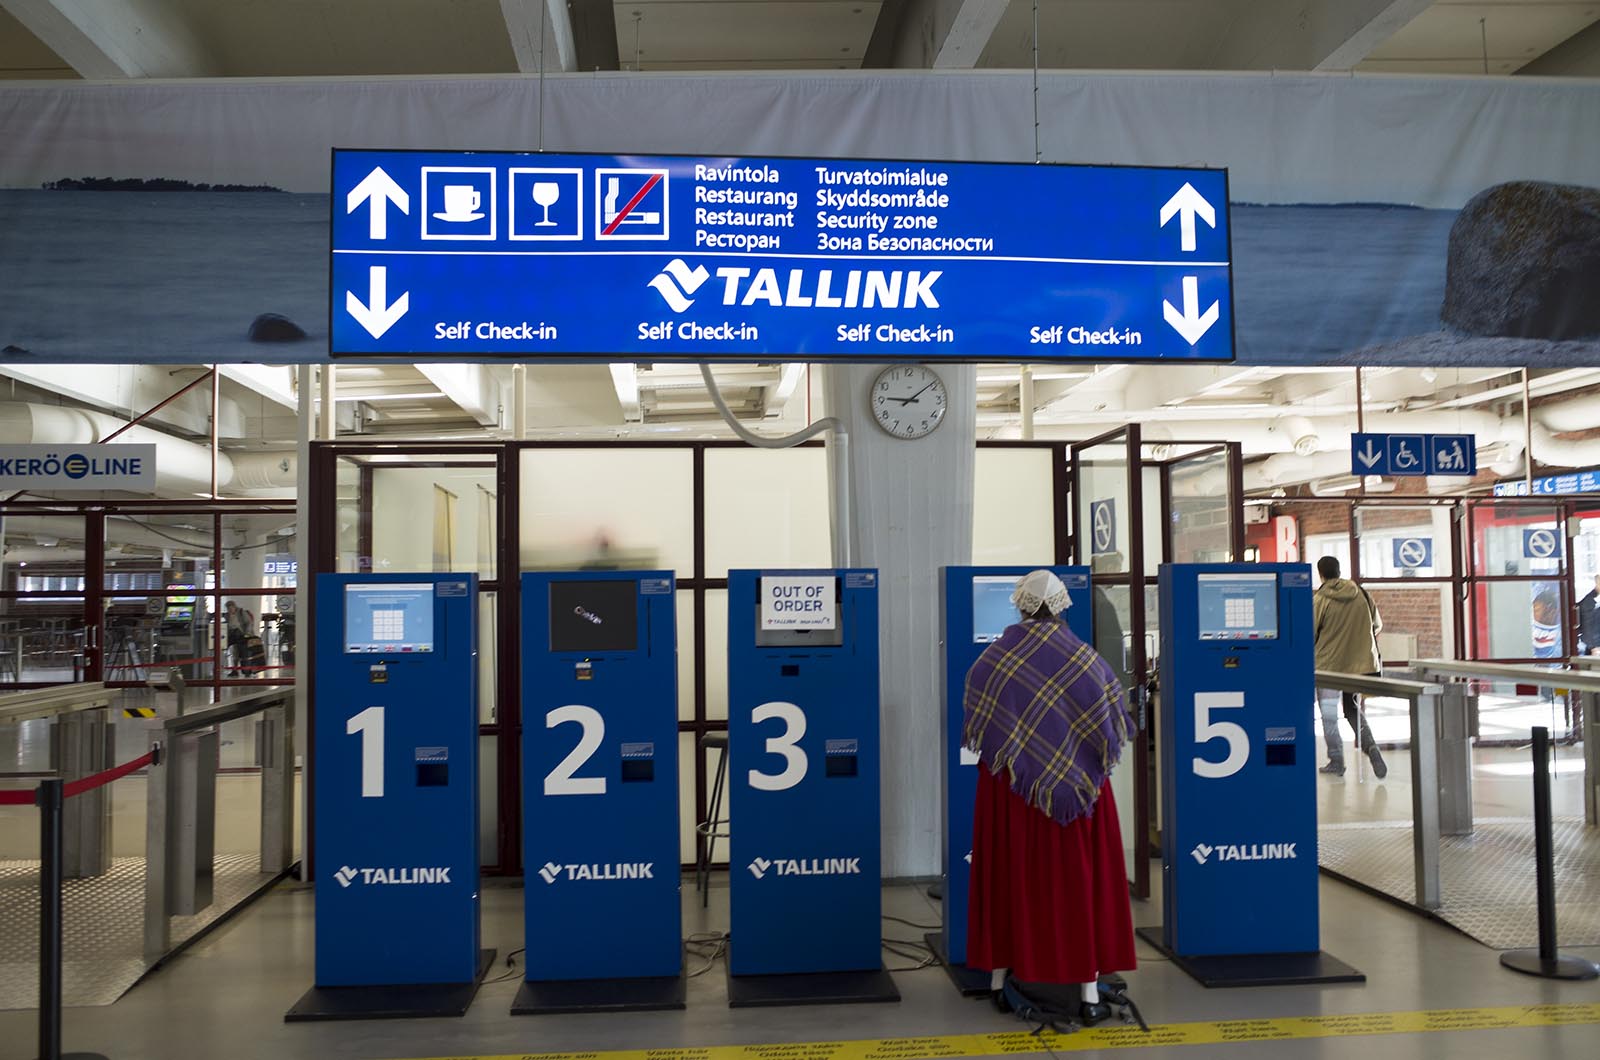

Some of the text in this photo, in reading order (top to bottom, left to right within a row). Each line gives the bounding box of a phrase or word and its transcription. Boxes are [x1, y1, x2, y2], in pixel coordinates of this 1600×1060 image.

[695, 164, 779, 183] Ravintola
[815, 167, 948, 186] Turvatoimialue
[695, 186, 797, 210] Restaurang
[816, 188, 949, 211] Skyddsområde
[695, 207, 794, 227] Restaurant
[816, 211, 938, 233] Security zone
[695, 229, 780, 252] Ресторан
[817, 232, 994, 251] Зона Безопасности
[716, 267, 943, 309] TALLINK
[435, 321, 557, 341] Self Check-in
[638, 321, 758, 341] Self Check-in
[837, 323, 954, 343] Self Check-in
[1030, 325, 1142, 345] Self Check-in
[882, 410, 889, 420] 8
[892, 420, 899, 432] 7
[906, 424, 914, 433] 6
[92, 458, 142, 476] LINE
[772, 586, 824, 598] OUT OF
[774, 600, 823, 612] ORDER
[1192, 691, 1250, 779] 5
[346, 706, 385, 798] 1
[543, 704, 607, 796] 2
[748, 701, 809, 791] 3
[1214, 842, 1297, 861] TALLINK
[360, 867, 451, 885] TALLINK
[564, 862, 654, 881] TALLINK
[773, 857, 861, 876] TALLINK
